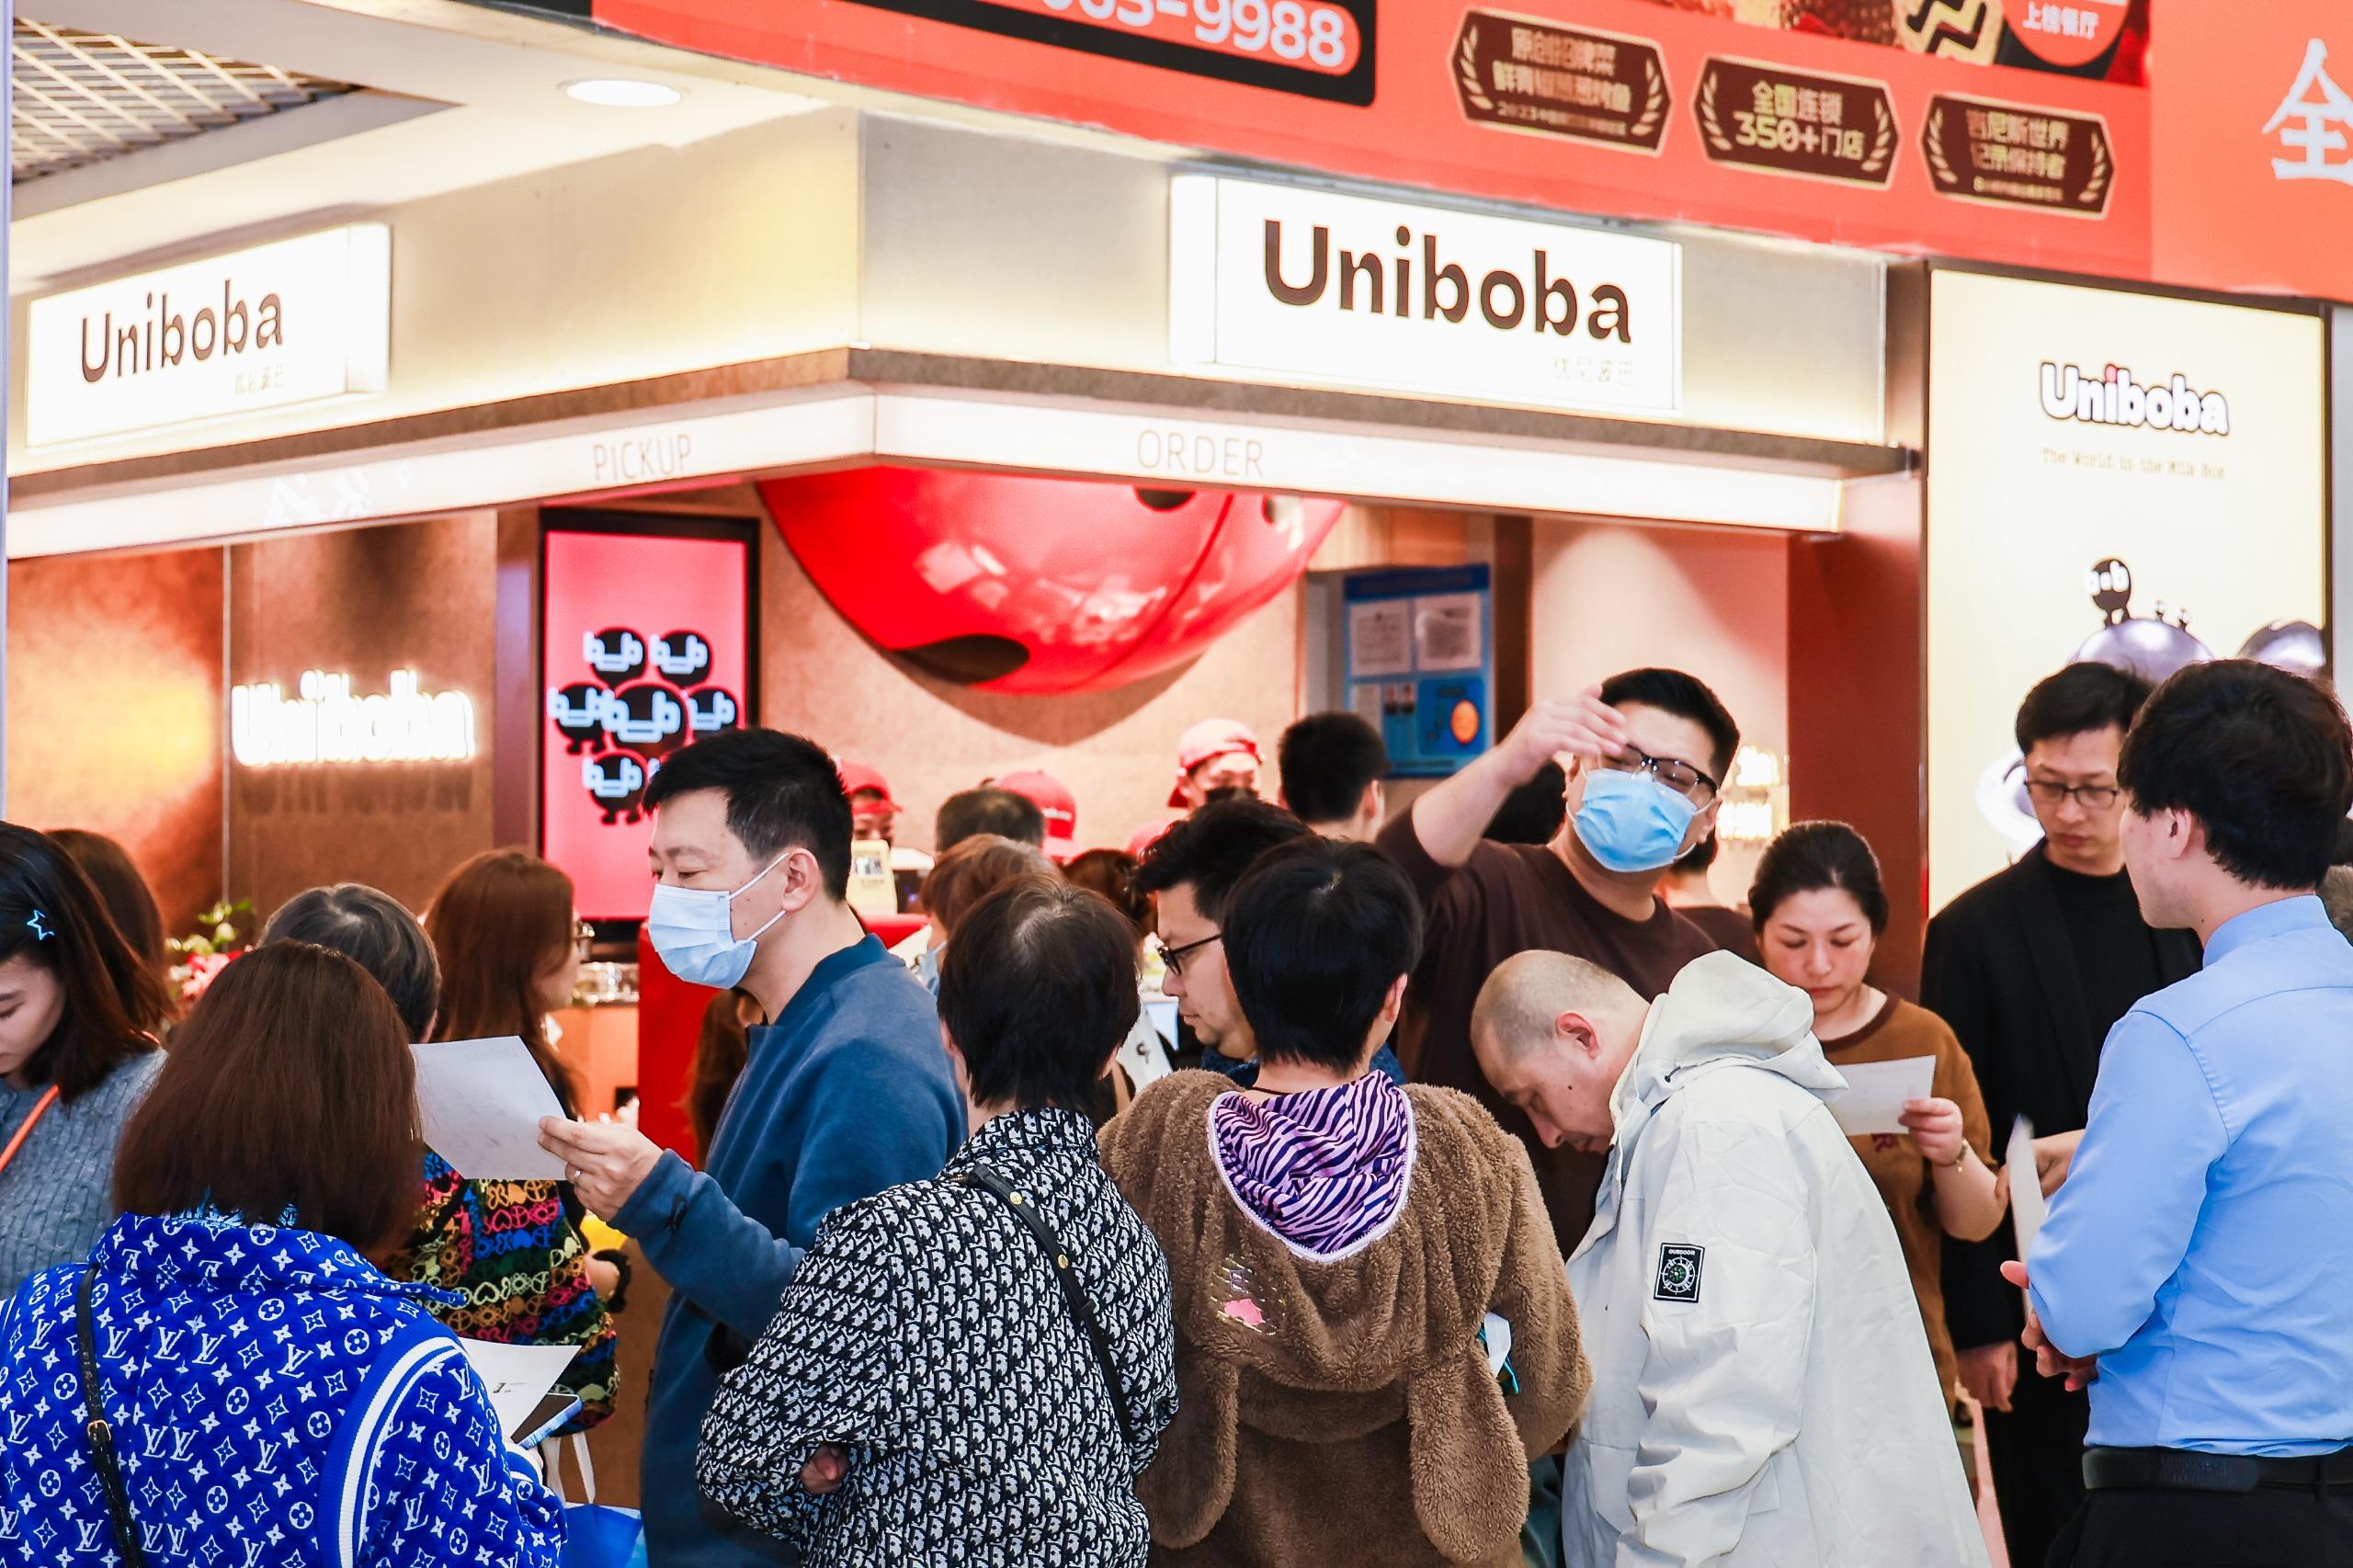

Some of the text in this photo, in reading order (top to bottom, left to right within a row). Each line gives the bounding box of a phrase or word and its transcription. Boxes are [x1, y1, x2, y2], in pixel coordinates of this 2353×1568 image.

[1733, 109, 1866, 161] 350+门店
[2261, 38, 2353, 187] 全
[1264, 218, 1631, 345] Uniboba
[81, 278, 283, 382] Uniboba
[2040, 361, 2230, 437] Uniboba
[593, 433, 692, 482] PICKUP
[1137, 429, 1265, 477] ORDER
[2042, 447, 2066, 464] The
[2140, 458, 2162, 474] the
